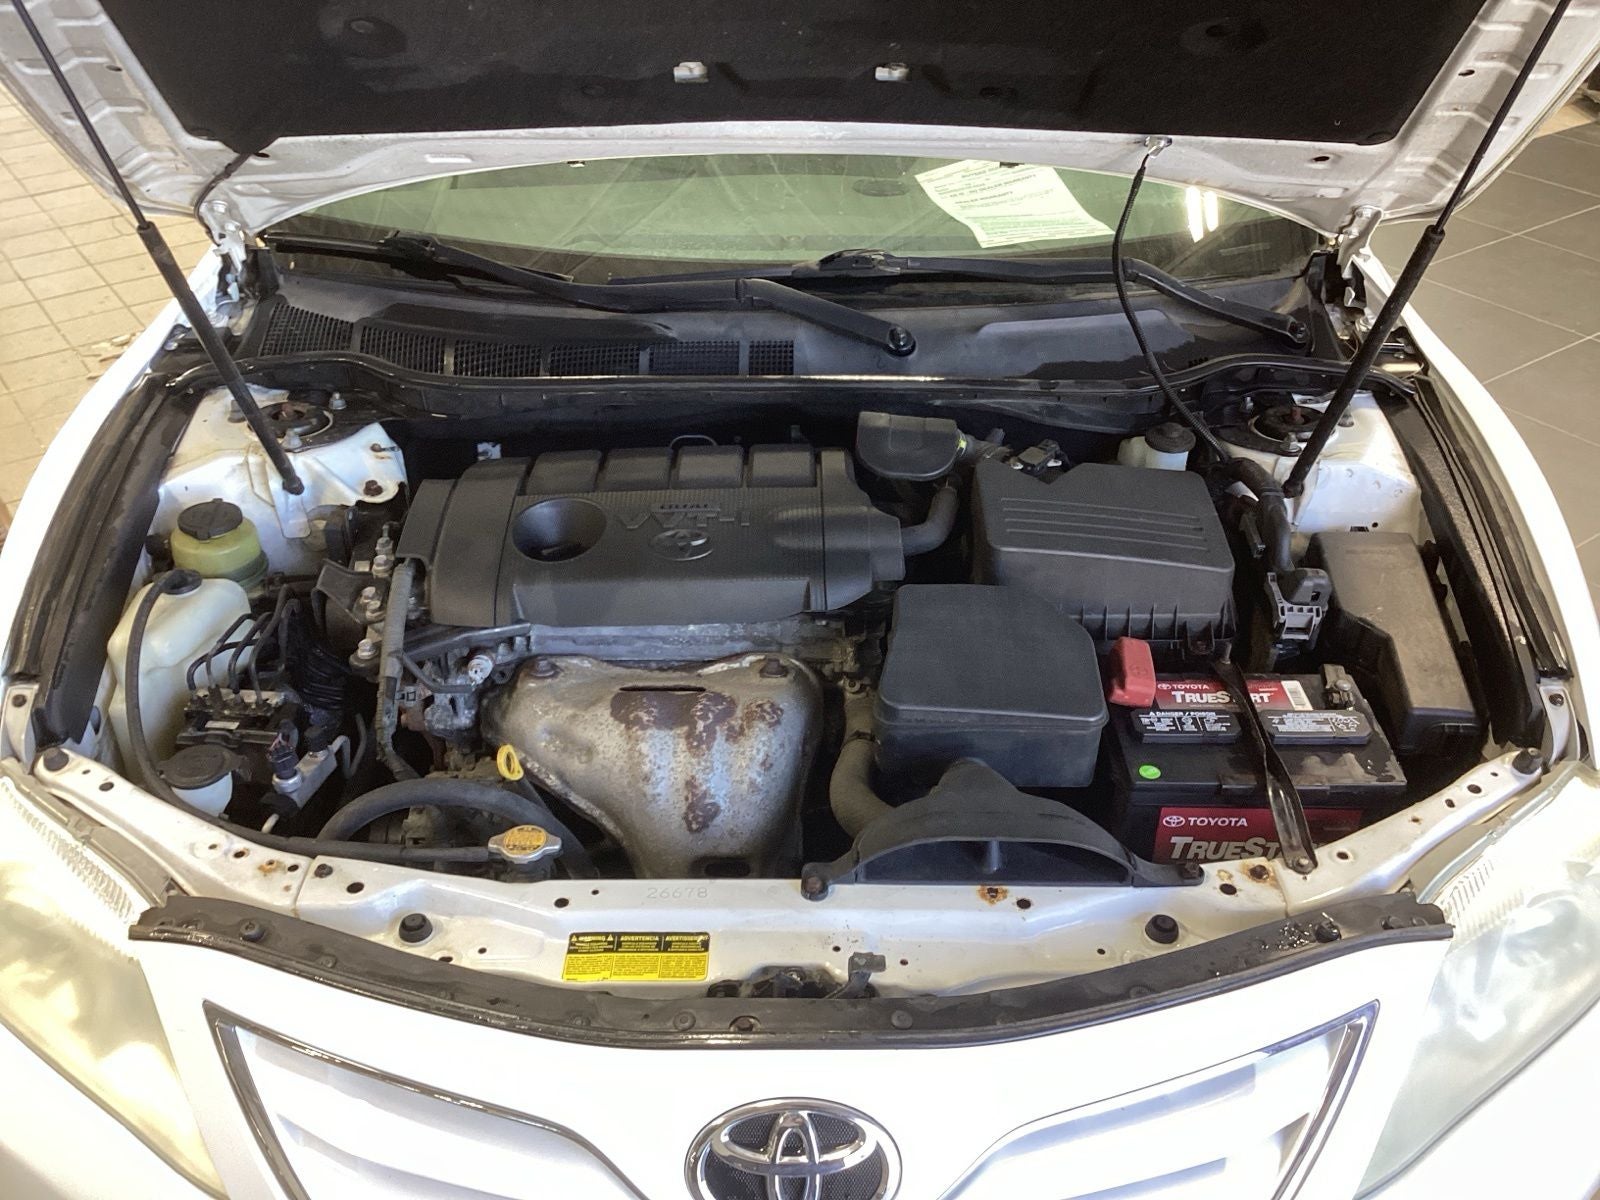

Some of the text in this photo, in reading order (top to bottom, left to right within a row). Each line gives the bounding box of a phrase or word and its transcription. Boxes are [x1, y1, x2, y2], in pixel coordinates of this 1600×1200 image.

[1172, 690, 1274, 704] TRUESRT
[1188, 816, 1248, 827] TOYOTA
[647, 887, 709, 899] 26678
